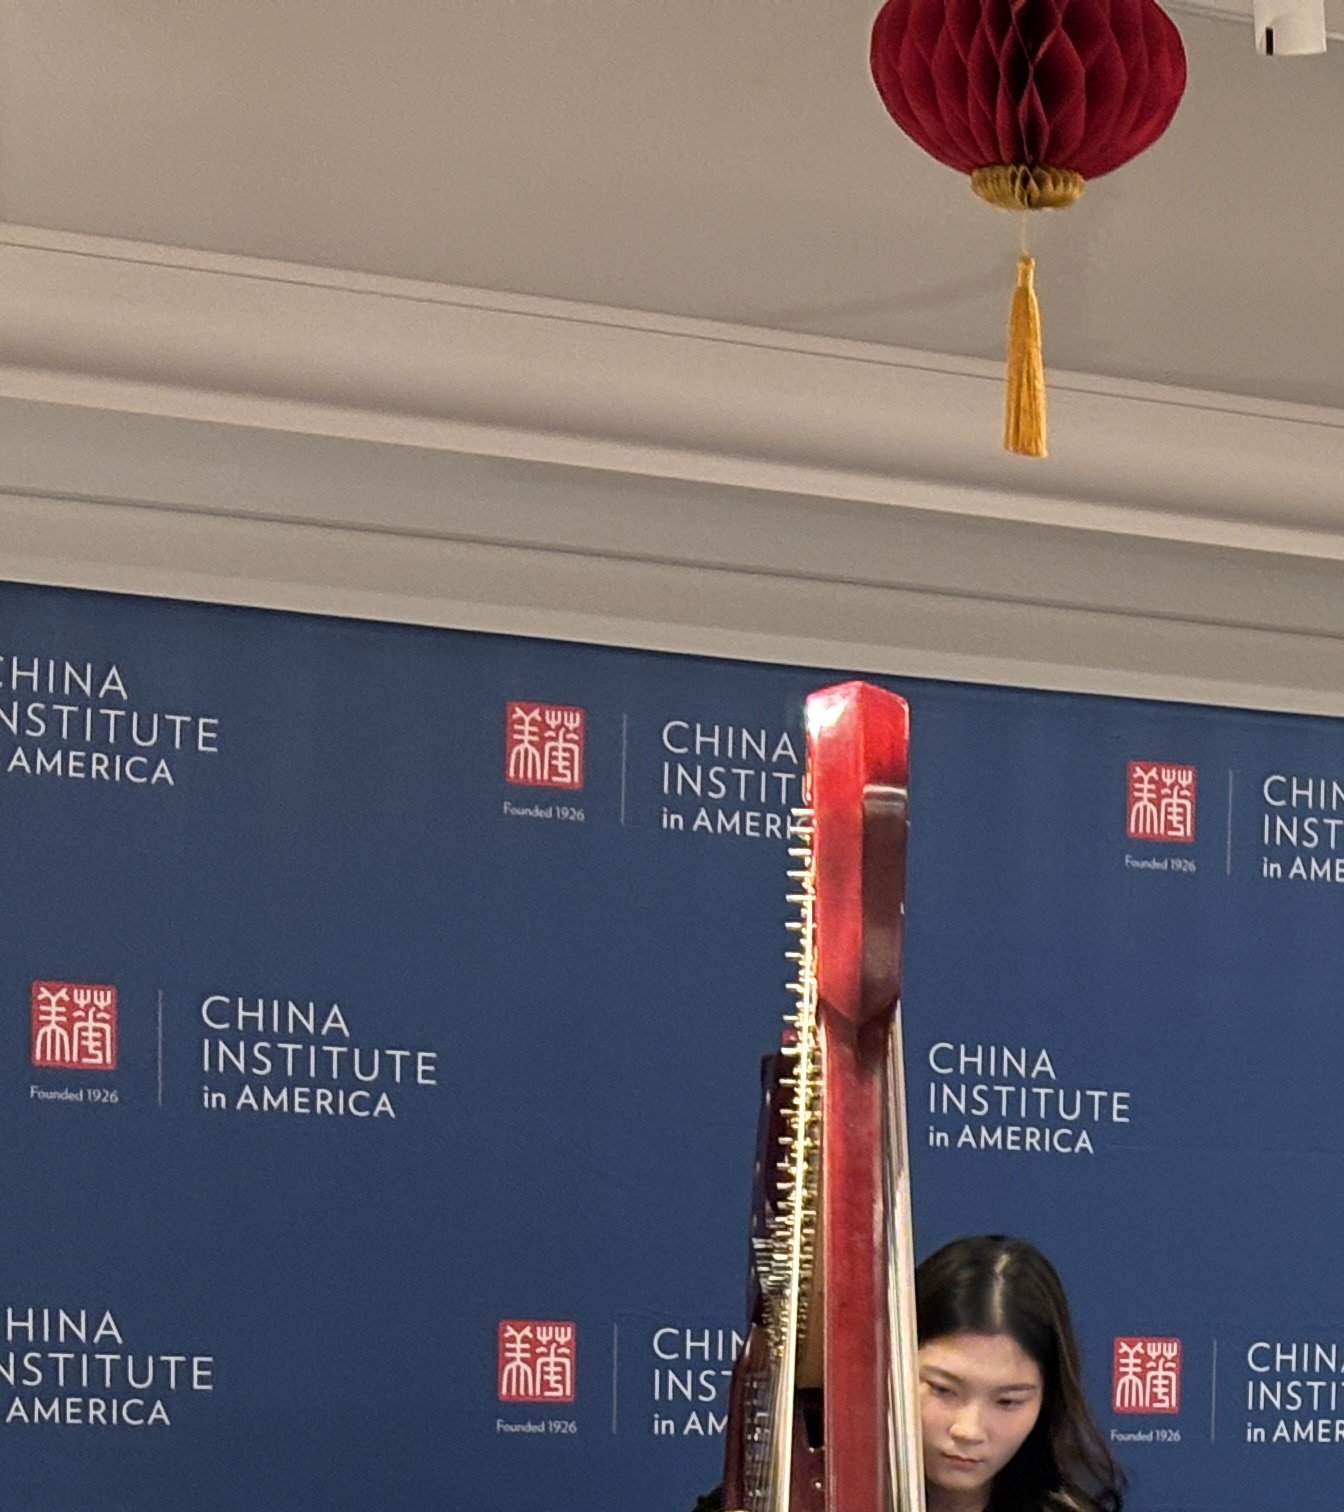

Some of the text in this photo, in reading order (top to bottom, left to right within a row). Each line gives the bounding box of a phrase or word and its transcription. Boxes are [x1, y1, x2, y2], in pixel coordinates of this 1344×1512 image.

[0, 655, 128, 700] HINA
[0, 701, 219, 753] NSTITUTE
[662, 720, 798, 765] CHINA
[7, 746, 175, 786] AMERICA
[663, 761, 808, 807] INSTIT
[503, 799, 587, 823] Founded 1926
[662, 807, 684, 831] in
[1125, 853, 1198, 874] Founded 1926
[1262, 856, 1282, 879] in
[201, 995, 350, 1038] CHINA
[203, 1038, 437, 1085] INSTITUTE
[928, 1042, 1056, 1080] CHINA
[30, 1084, 121, 1104] Founded 1926
[203, 1084, 396, 1119] in AMERICA
[929, 1082, 1131, 1123] INSTITUTE
[929, 1124, 1094, 1154] in AMERICA
[6, 1307, 123, 1345] HINA
[0, 1351, 213, 1390] NSTITUTE
[5, 1396, 171, 1426] AMERICA
[496, 1418, 579, 1435] Founded 1926
[653, 1413, 675, 1436] in
[1110, 1428, 1183, 1443] Founded 1926
[1246, 1422, 1266, 1443] in
